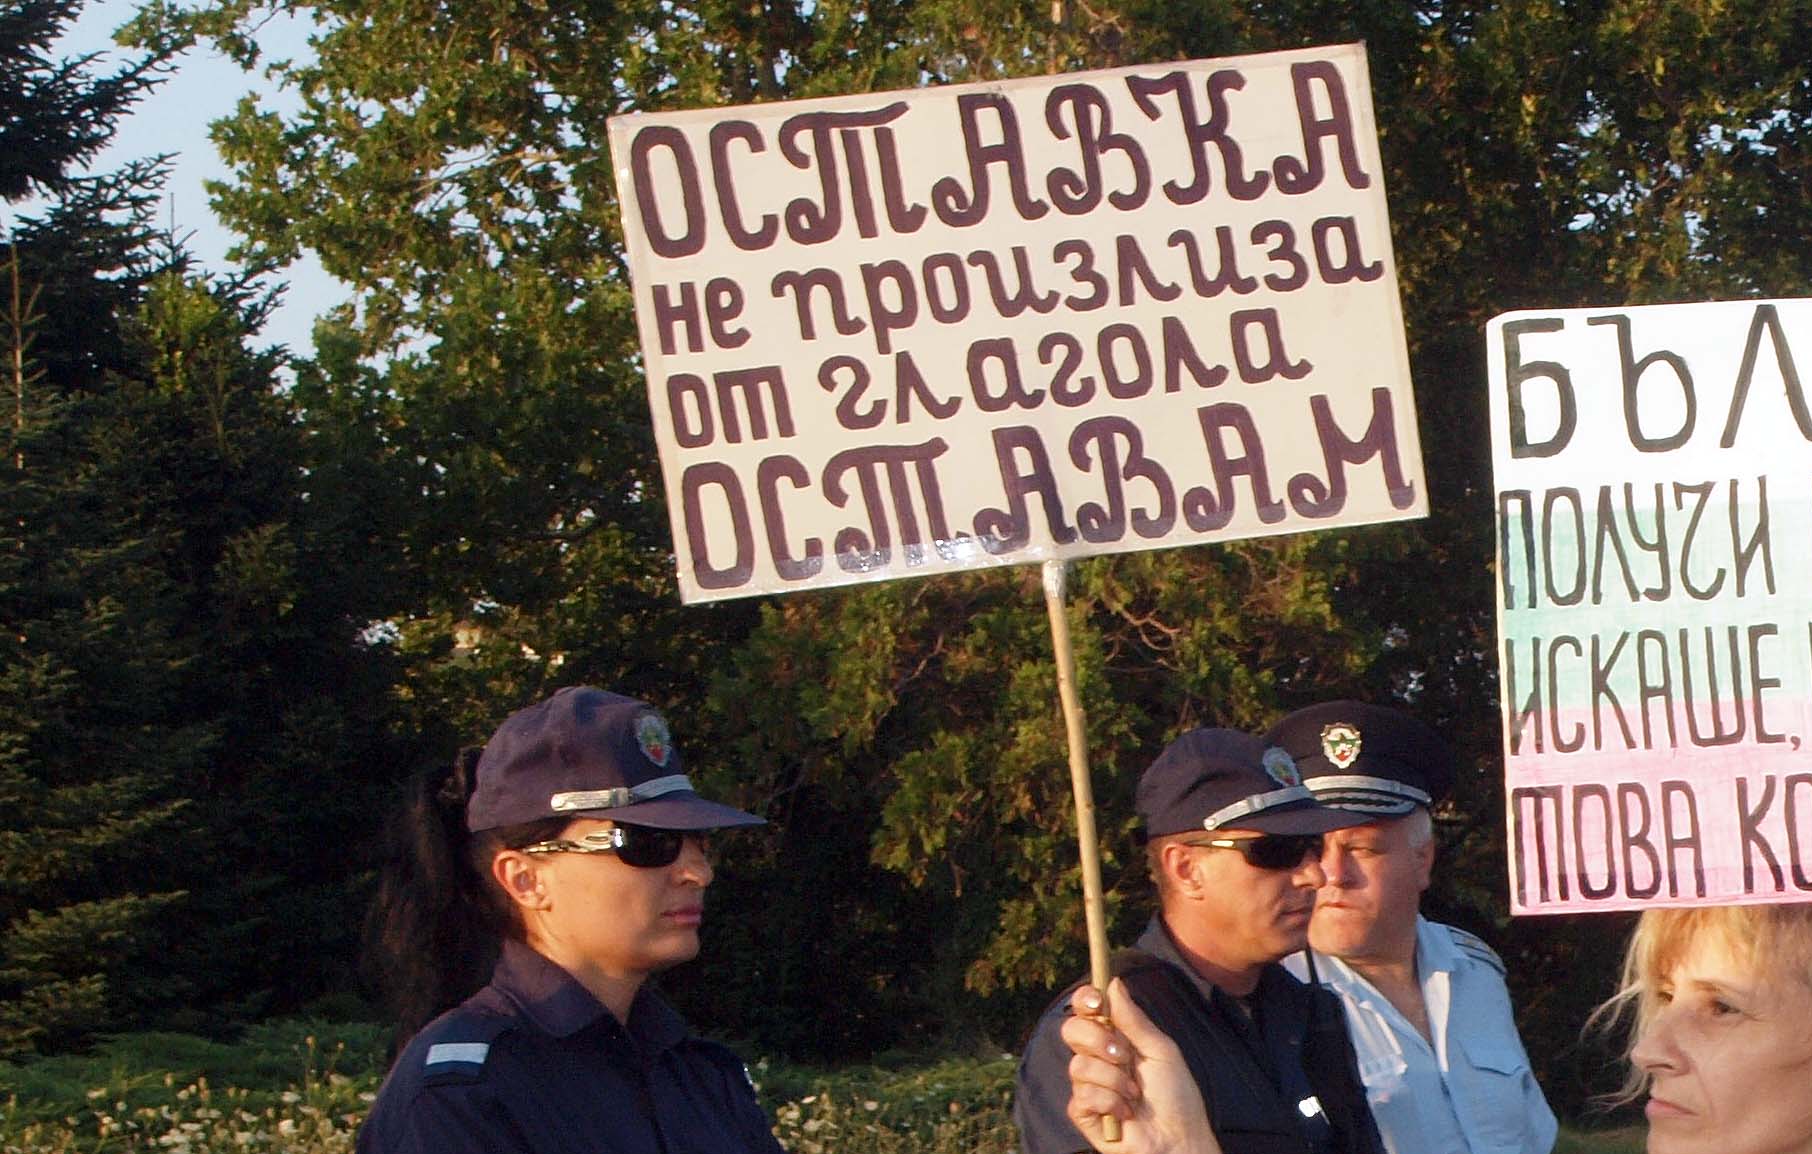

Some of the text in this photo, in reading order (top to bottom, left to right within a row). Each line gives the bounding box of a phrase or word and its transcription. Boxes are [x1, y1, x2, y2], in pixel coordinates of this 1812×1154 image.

[631, 61, 1370, 258] ОСТАВКА
[652, 217, 1384, 354] не произлиза
[667, 308, 1313, 449] от глагола
[682, 387, 1414, 590] ОСТАВАМ
[1498, 475, 1776, 610] ПОЛУЧИ
[1512, 780, 1706, 907] ТОВА
